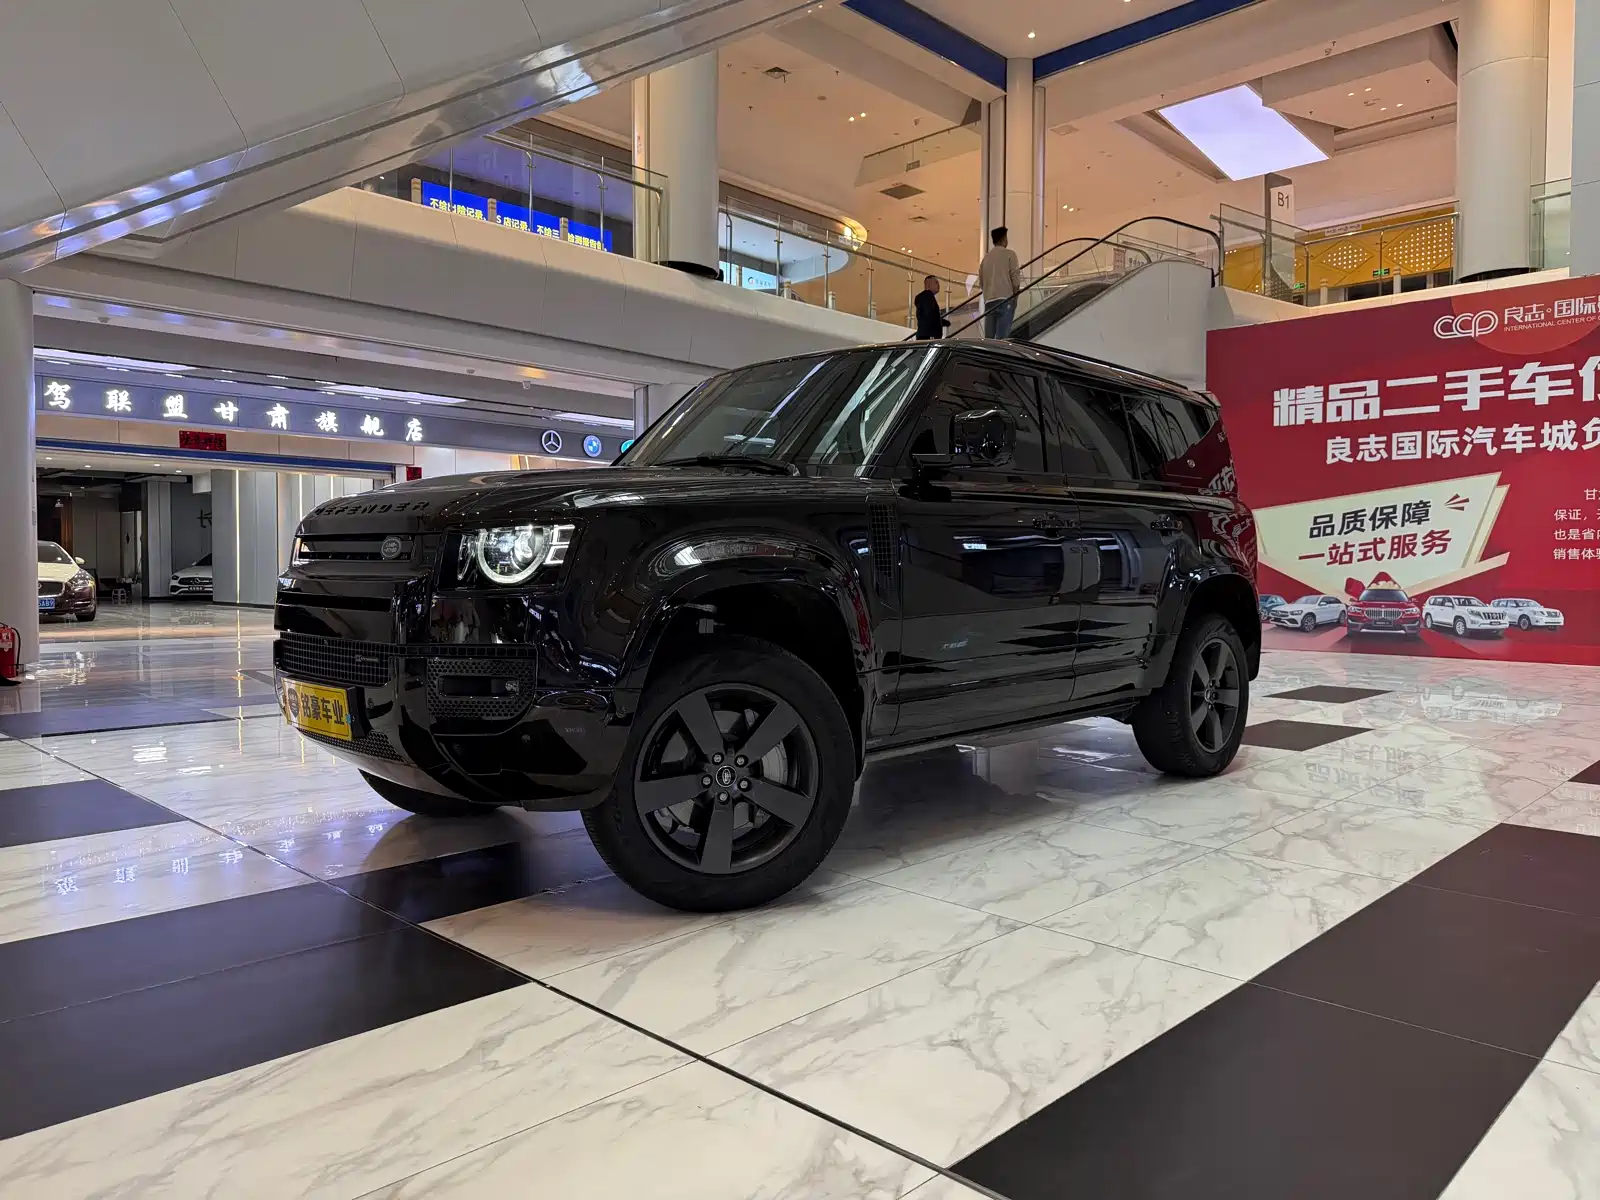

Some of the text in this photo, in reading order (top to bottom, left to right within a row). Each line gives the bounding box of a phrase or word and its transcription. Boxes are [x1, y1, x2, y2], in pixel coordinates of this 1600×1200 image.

[1277, 192, 1290, 209] B1
[1503, 321, 1556, 332] INTERNATIONAL
[1556, 317, 1586, 326] CENTER
[1583, 487, 1600, 501] 甘
[314, 501, 430, 516] DEFENDER
[1309, 500, 1432, 539] 品质保障
[1553, 527, 1600, 541] 也是省
[1298, 529, 1452, 566] 一站式服务
